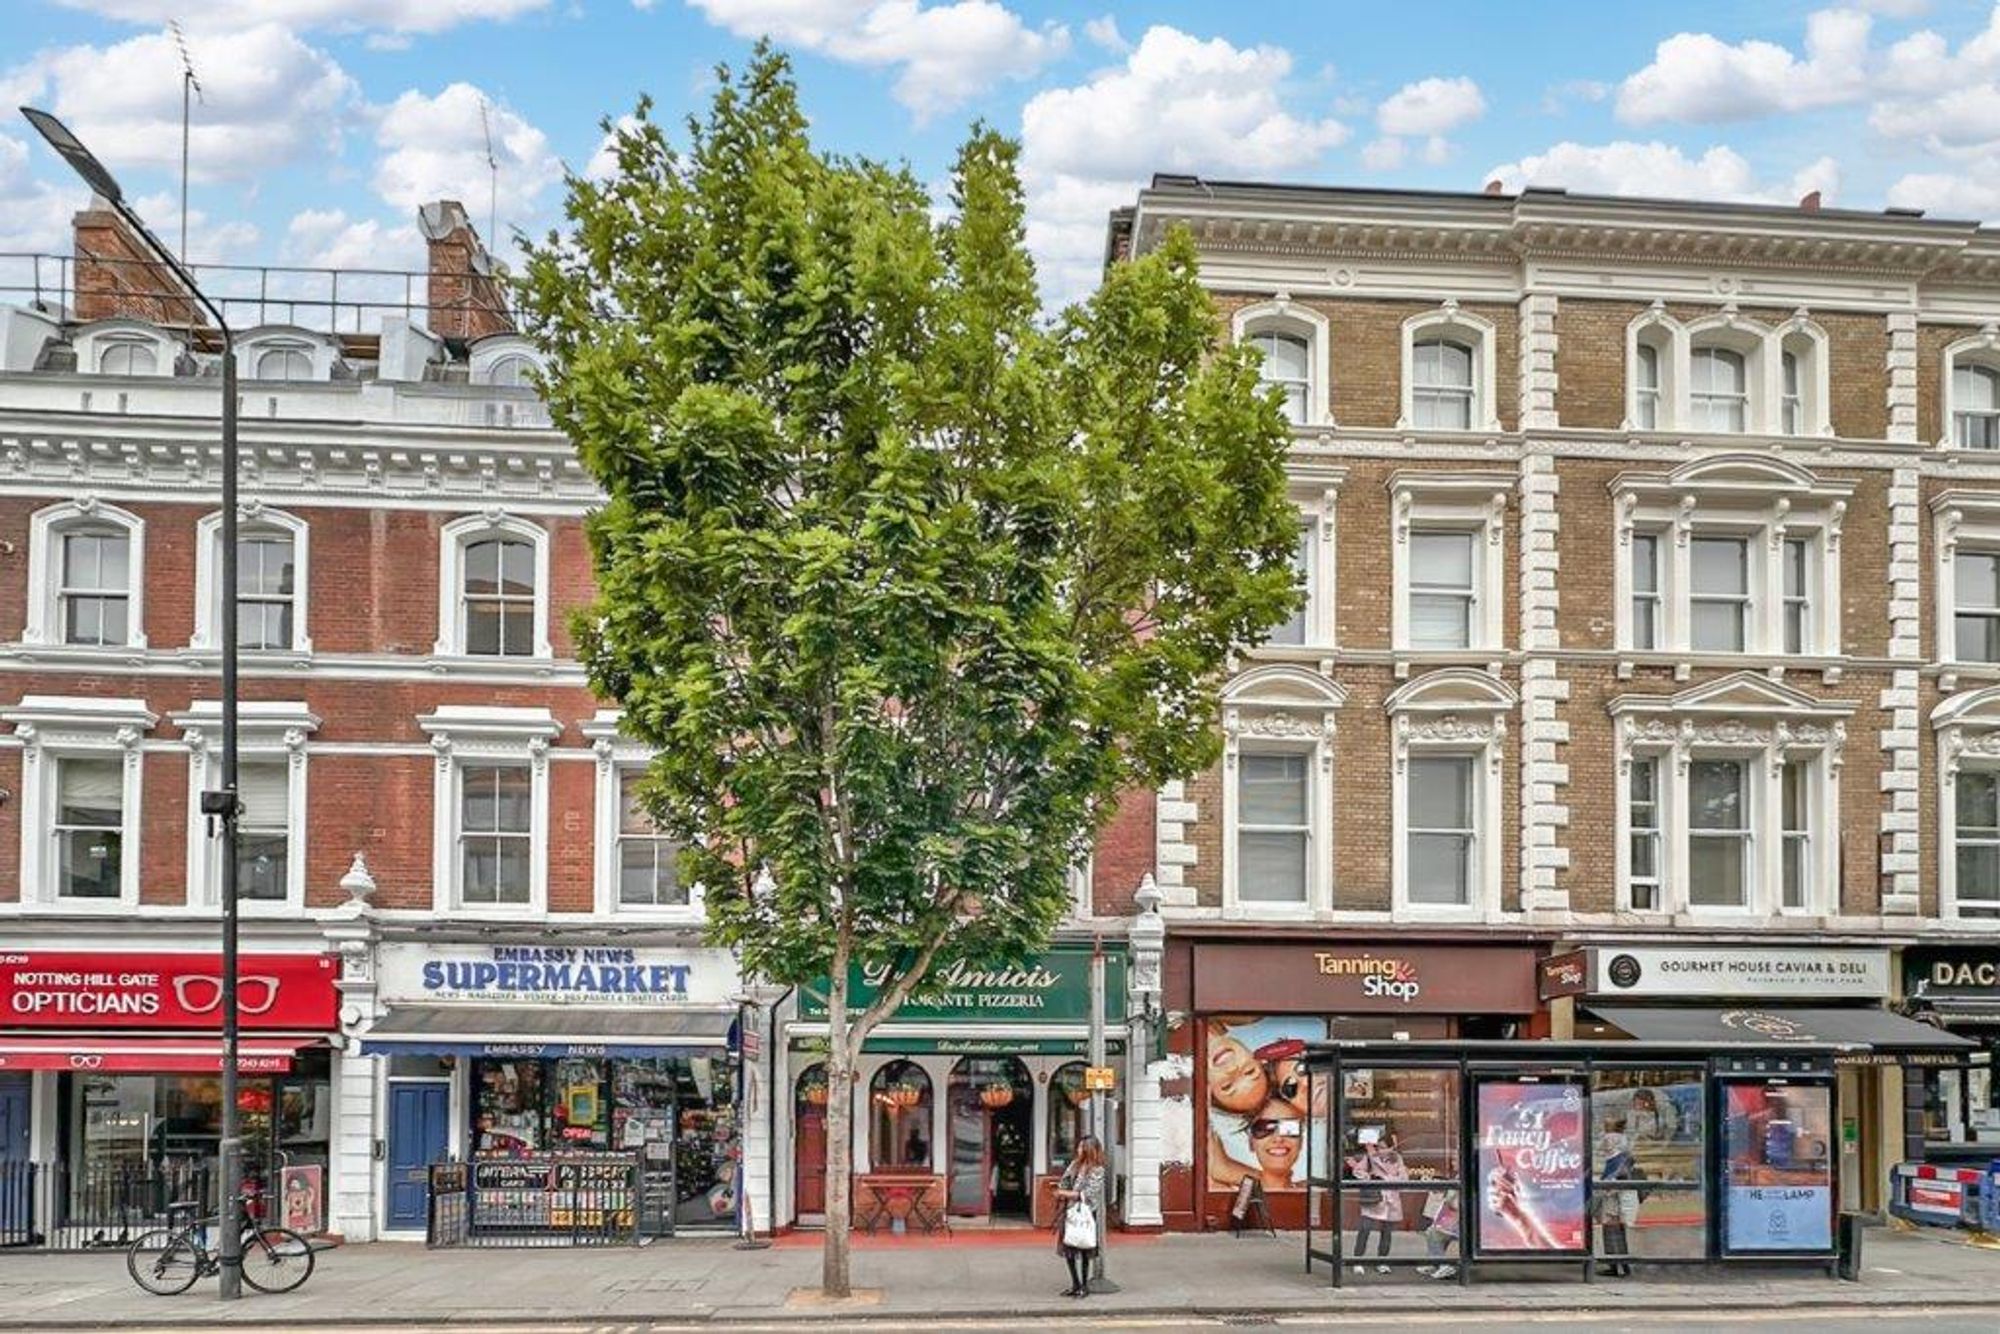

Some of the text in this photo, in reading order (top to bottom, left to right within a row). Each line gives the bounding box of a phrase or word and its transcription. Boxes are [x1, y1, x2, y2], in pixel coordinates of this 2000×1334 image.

[494, 947, 635, 963] EMBASSY NEWS
[423, 961, 691, 993] SUPERMARKET
[1315, 953, 1420, 1002] Tanning Shop
[1660, 960, 1867, 974] GOURMET HOUSE CAVIAR & DELI
[1934, 962, 2000, 985] DAC
[13, 972, 160, 987] NOTTING HILL GATE
[12, 991, 161, 1014] OPTICIANS
[978, 994, 1044, 1008] PIZZERIA
[484, 1045, 606, 1055] EMBASSY NEWS
[1485, 1125, 1551, 1150] Fancy
[1515, 1147, 1582, 1173] Coffee
